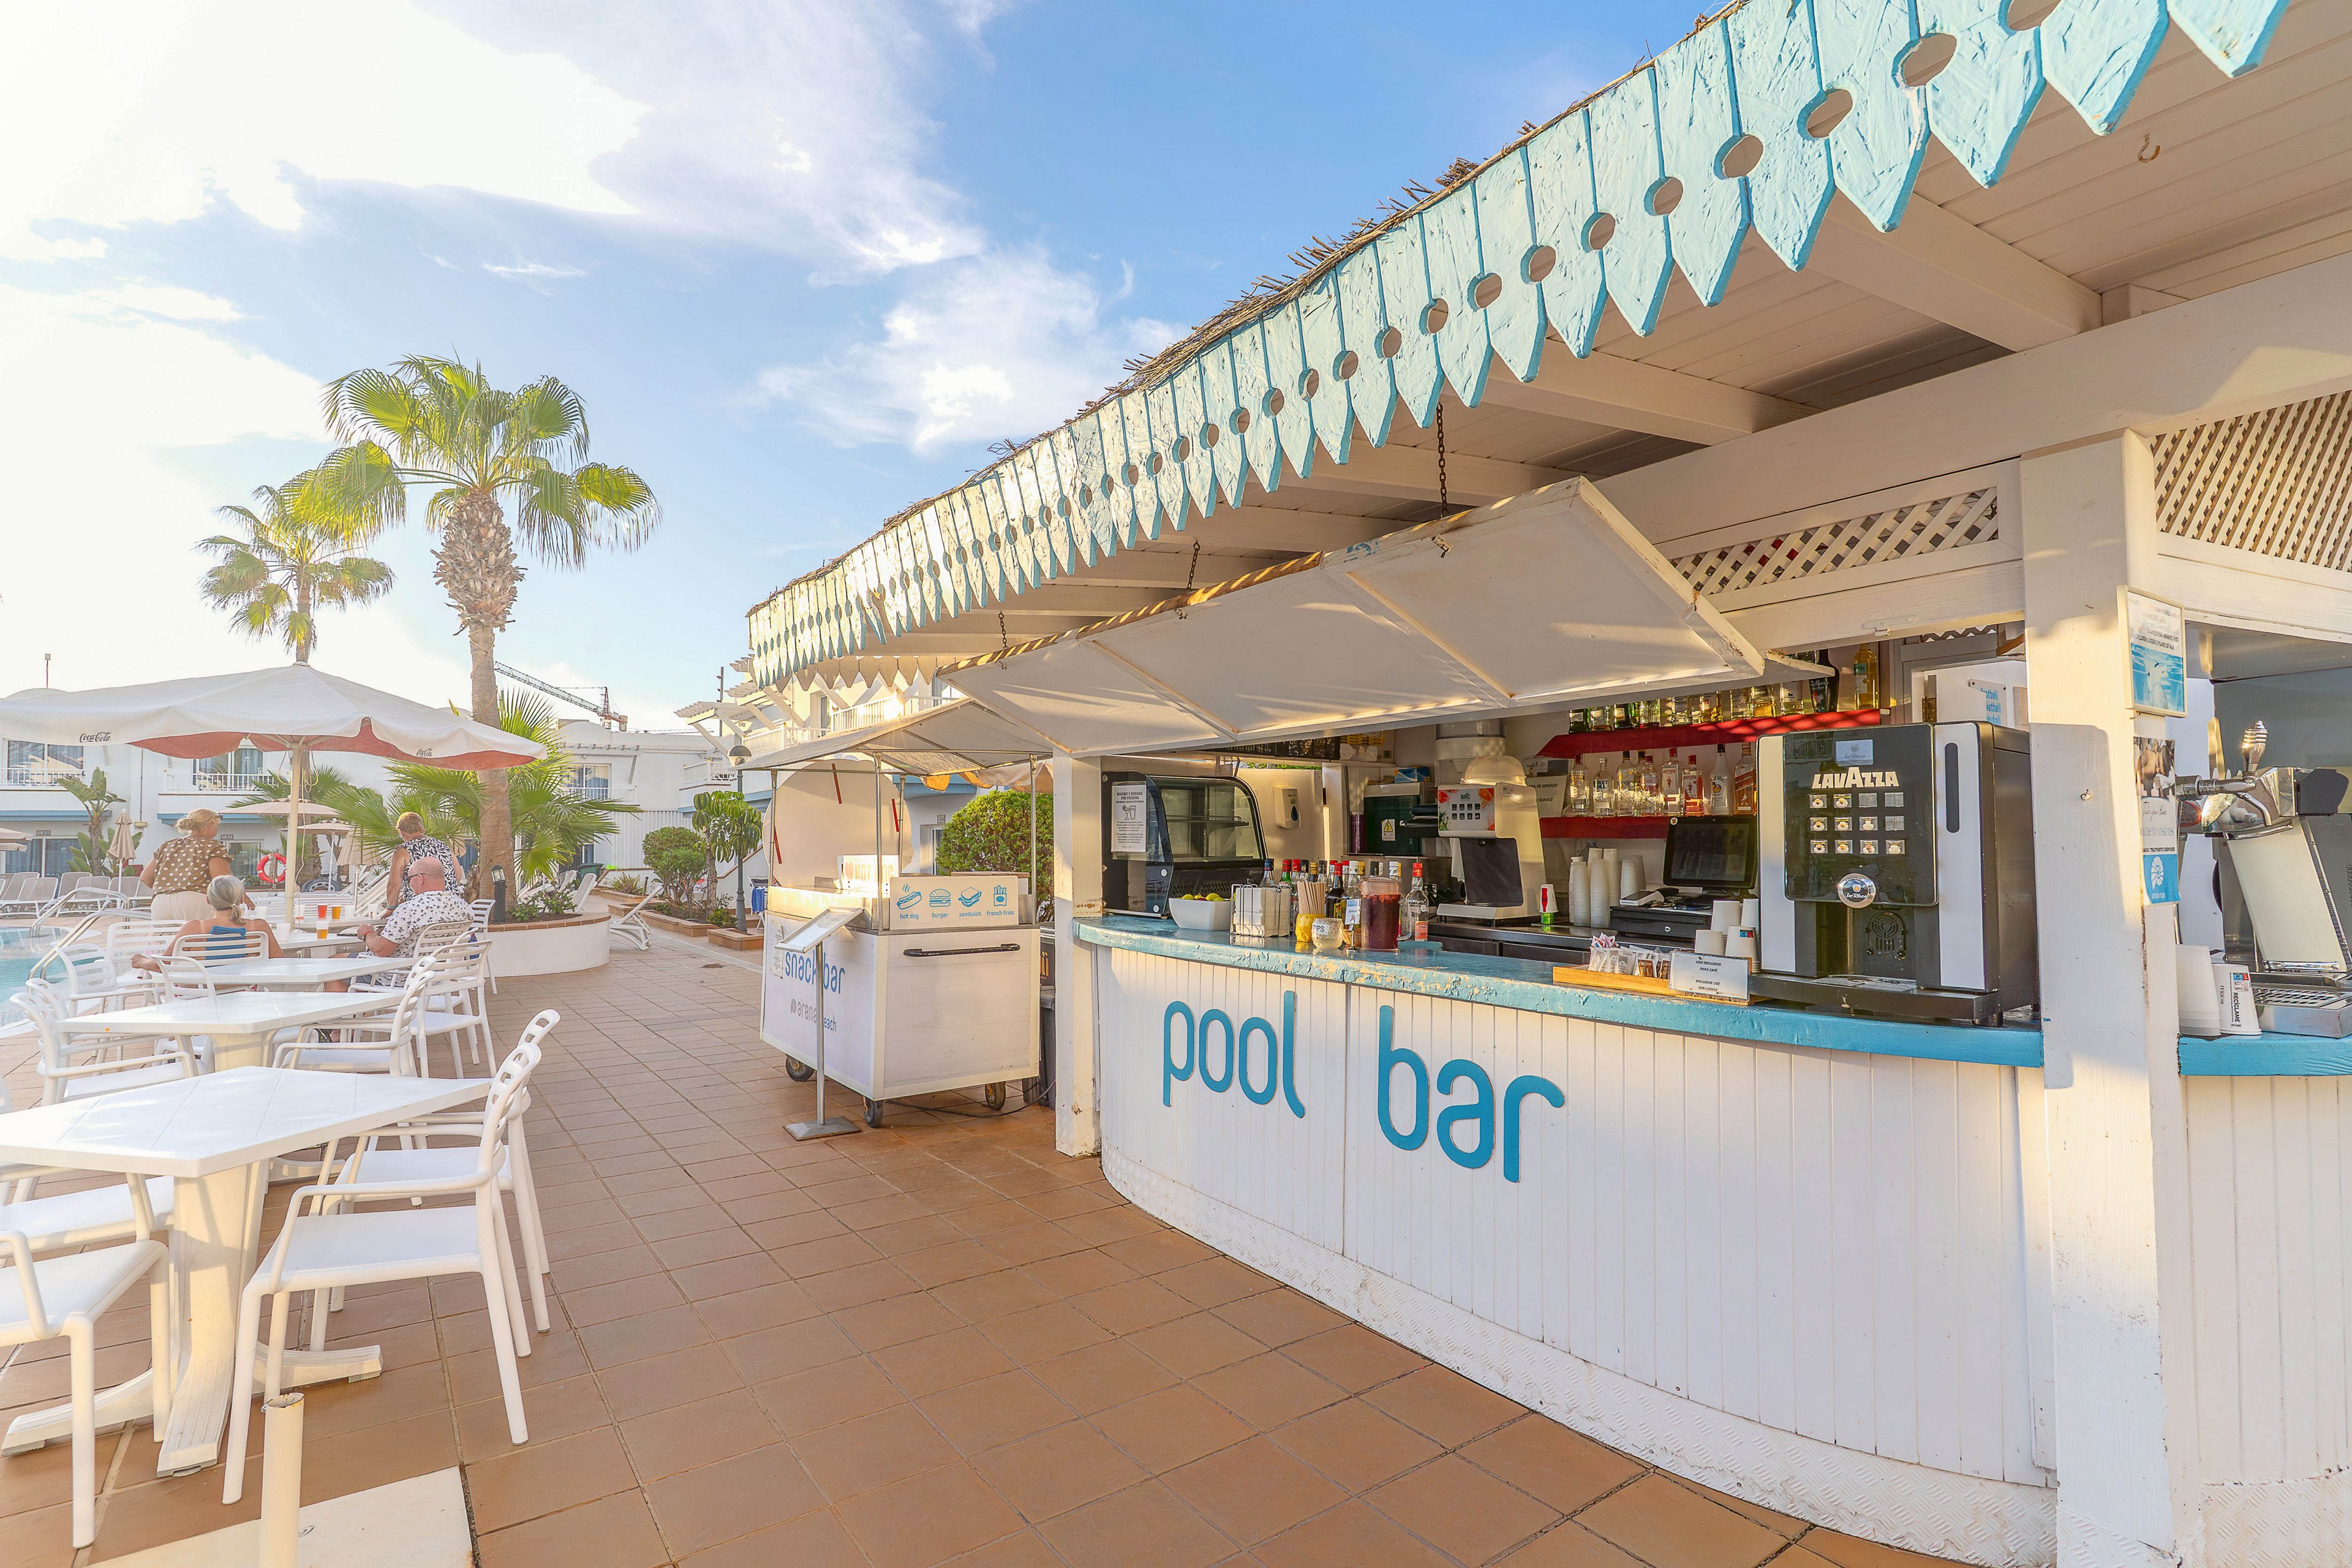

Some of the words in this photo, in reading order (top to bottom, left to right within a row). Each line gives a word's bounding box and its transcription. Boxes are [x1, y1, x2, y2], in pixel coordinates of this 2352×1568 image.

[79, 732, 111, 742] Coca-Cola
[1812, 766, 1899, 789] LAVAZZA
[854, 864, 871, 881] HOT
[823, 952, 845, 994] bar
[797, 1001, 817, 1024] arena
[823, 1015, 837, 1032] each
[1163, 990, 1306, 1118] pool
[1377, 1005, 1566, 1183] bar
